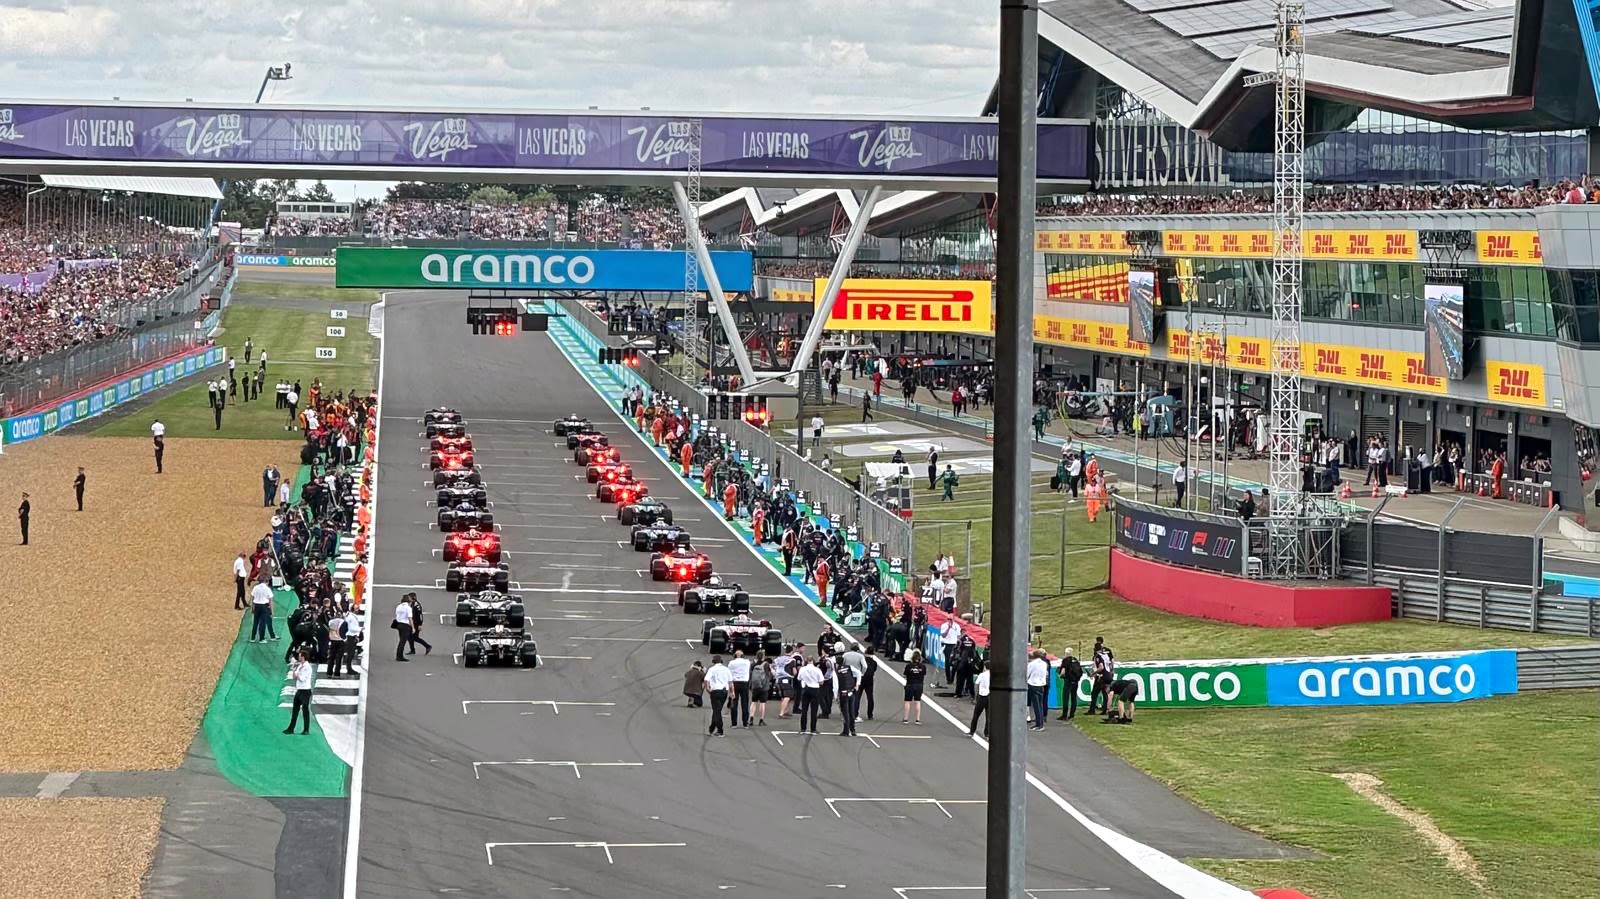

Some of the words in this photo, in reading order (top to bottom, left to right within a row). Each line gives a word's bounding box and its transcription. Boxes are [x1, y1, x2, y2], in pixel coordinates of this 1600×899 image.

[219, 115, 239, 128] LAS
[445, 120, 465, 132] LAS
[669, 123, 689, 135] LAS
[65, 119, 87, 147] LAS
[90, 119, 134, 148] VEGAS
[177, 117, 251, 157] Vegas
[294, 122, 315, 151] LAS
[318, 123, 361, 152] VEGAS
[404, 122, 477, 161] Vegas
[519, 127, 541, 155] LAS
[543, 127, 586, 156] VEGAS
[890, 128, 910, 141] LAS
[743, 131, 765, 159] LAS
[767, 132, 809, 160] VEGAS
[850, 128, 922, 170] Vegas
[963, 134, 986, 161] LAS
[1314, 234, 1335, 254] DHL
[1348, 234, 1371, 254] DHL
[1385, 234, 1409, 255] DHL
[1486, 235, 1514, 258] DHL
[237, 255, 279, 265] aramco
[292, 257, 336, 266] aramco
[421, 253, 595, 284] aramco
[832, 288, 974, 322] PIRELLI
[1317, 349, 1342, 375] DHL
[1360, 353, 1388, 380] DHL
[1499, 368, 1529, 399] DHL
[13, 416, 40, 439] aramco
[813, 501, 821, 509] 11
[830, 513, 840, 521] 22
[847, 525, 857, 533] 24
[870, 542, 880, 551] 21
[890, 557, 902, 566] 20
[922, 587, 933, 596] 77
[1076, 670, 1242, 702] aamco
[1298, 663, 1476, 699] aramco
